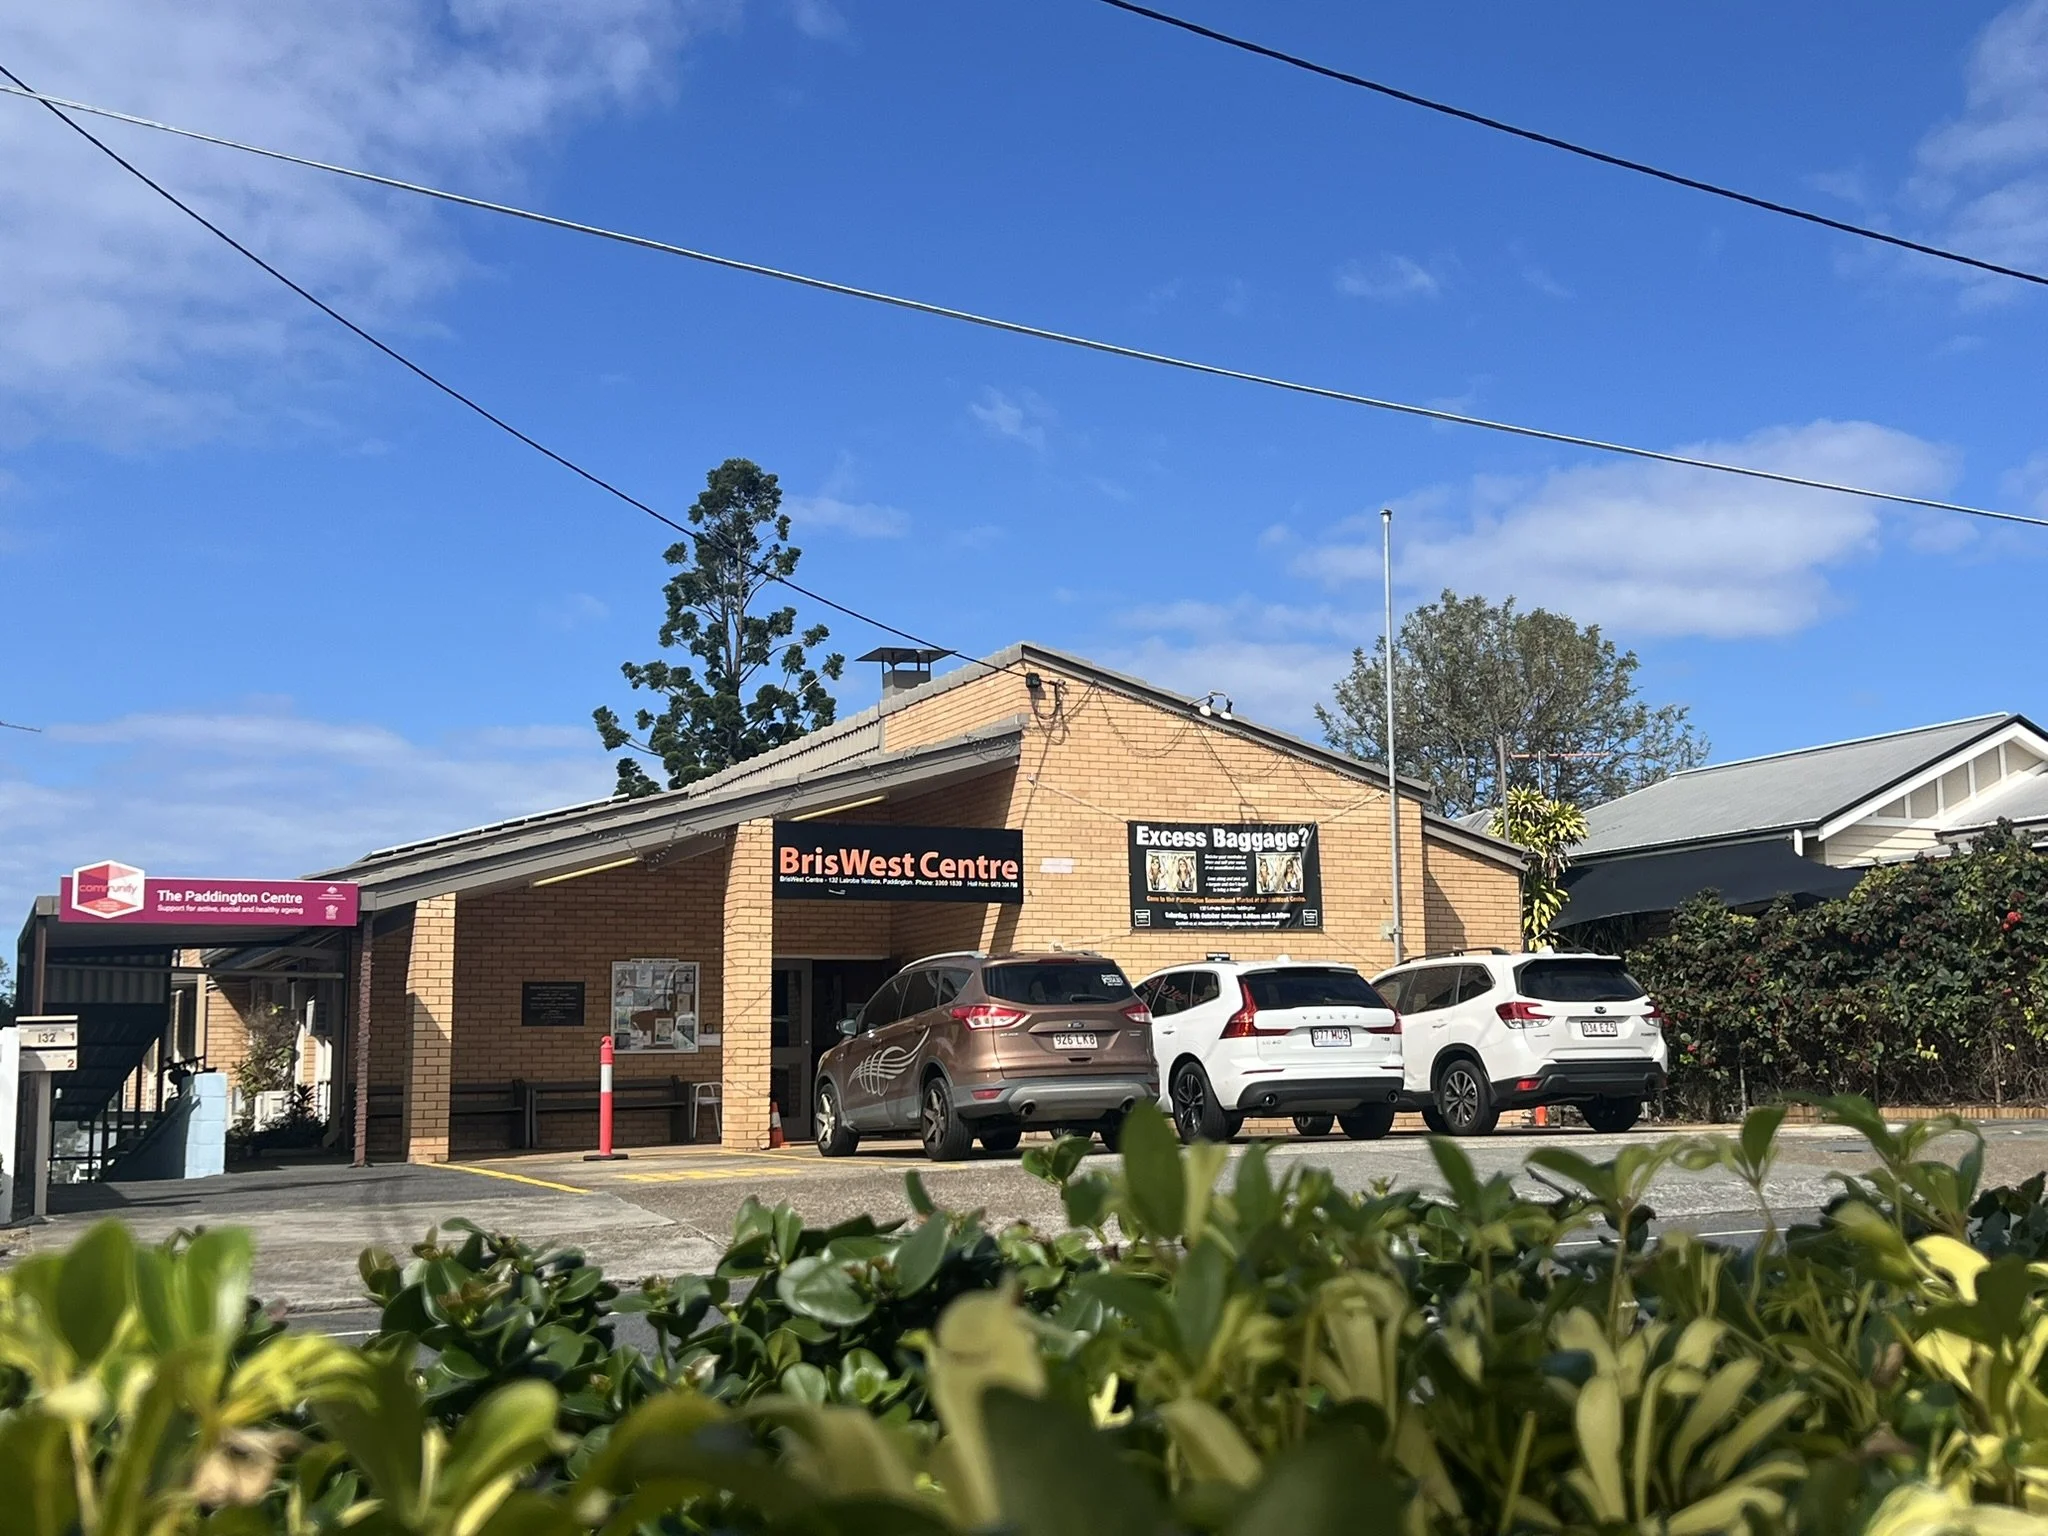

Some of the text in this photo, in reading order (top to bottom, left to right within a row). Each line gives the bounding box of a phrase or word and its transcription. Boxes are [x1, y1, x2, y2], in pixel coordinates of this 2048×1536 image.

[1136, 825, 1309, 852] Excess Baggage?
[779, 847, 1019, 880] BrisWest Centre
[79, 883, 138, 895] community
[157, 890, 303, 905] The Paddington Centre
[157, 904, 185, 912] Support
[186, 904, 196, 912] for
[197, 905, 219, 913] active,
[256, 906, 279, 914] healthy
[280, 907, 303, 915] ageing
[38, 1032, 75, 1043] 132 1
[67, 1059, 75, 1068] 2
